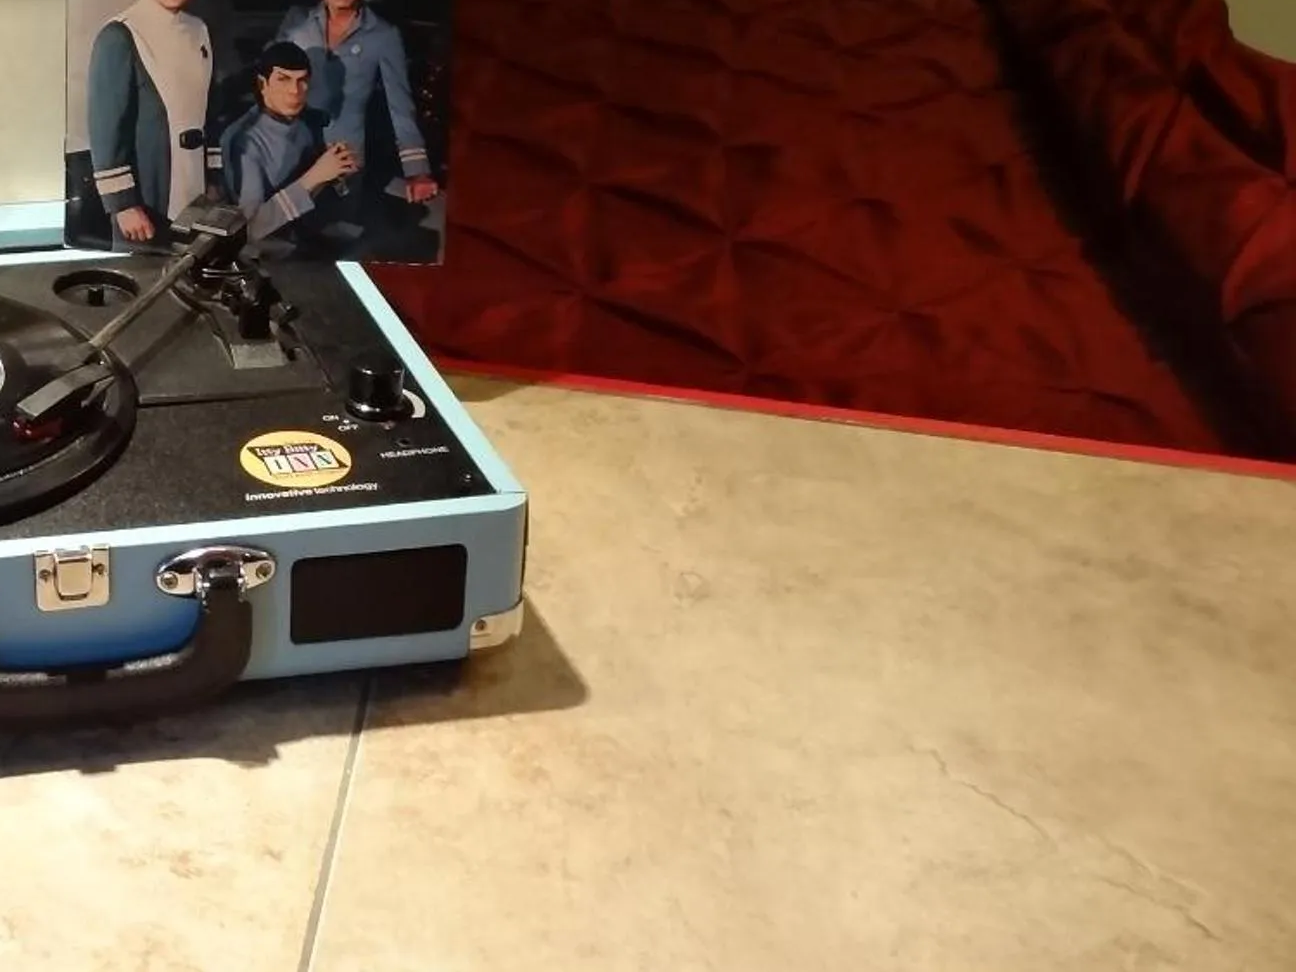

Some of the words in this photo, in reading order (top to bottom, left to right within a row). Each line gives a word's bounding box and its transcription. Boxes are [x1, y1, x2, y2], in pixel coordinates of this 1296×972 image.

[322, 414, 340, 422] ON
[338, 424, 359, 432] OFF
[380, 446, 450, 459] HEADPHONE
[244, 488, 313, 502] Innovative
[313, 482, 378, 497] technology
